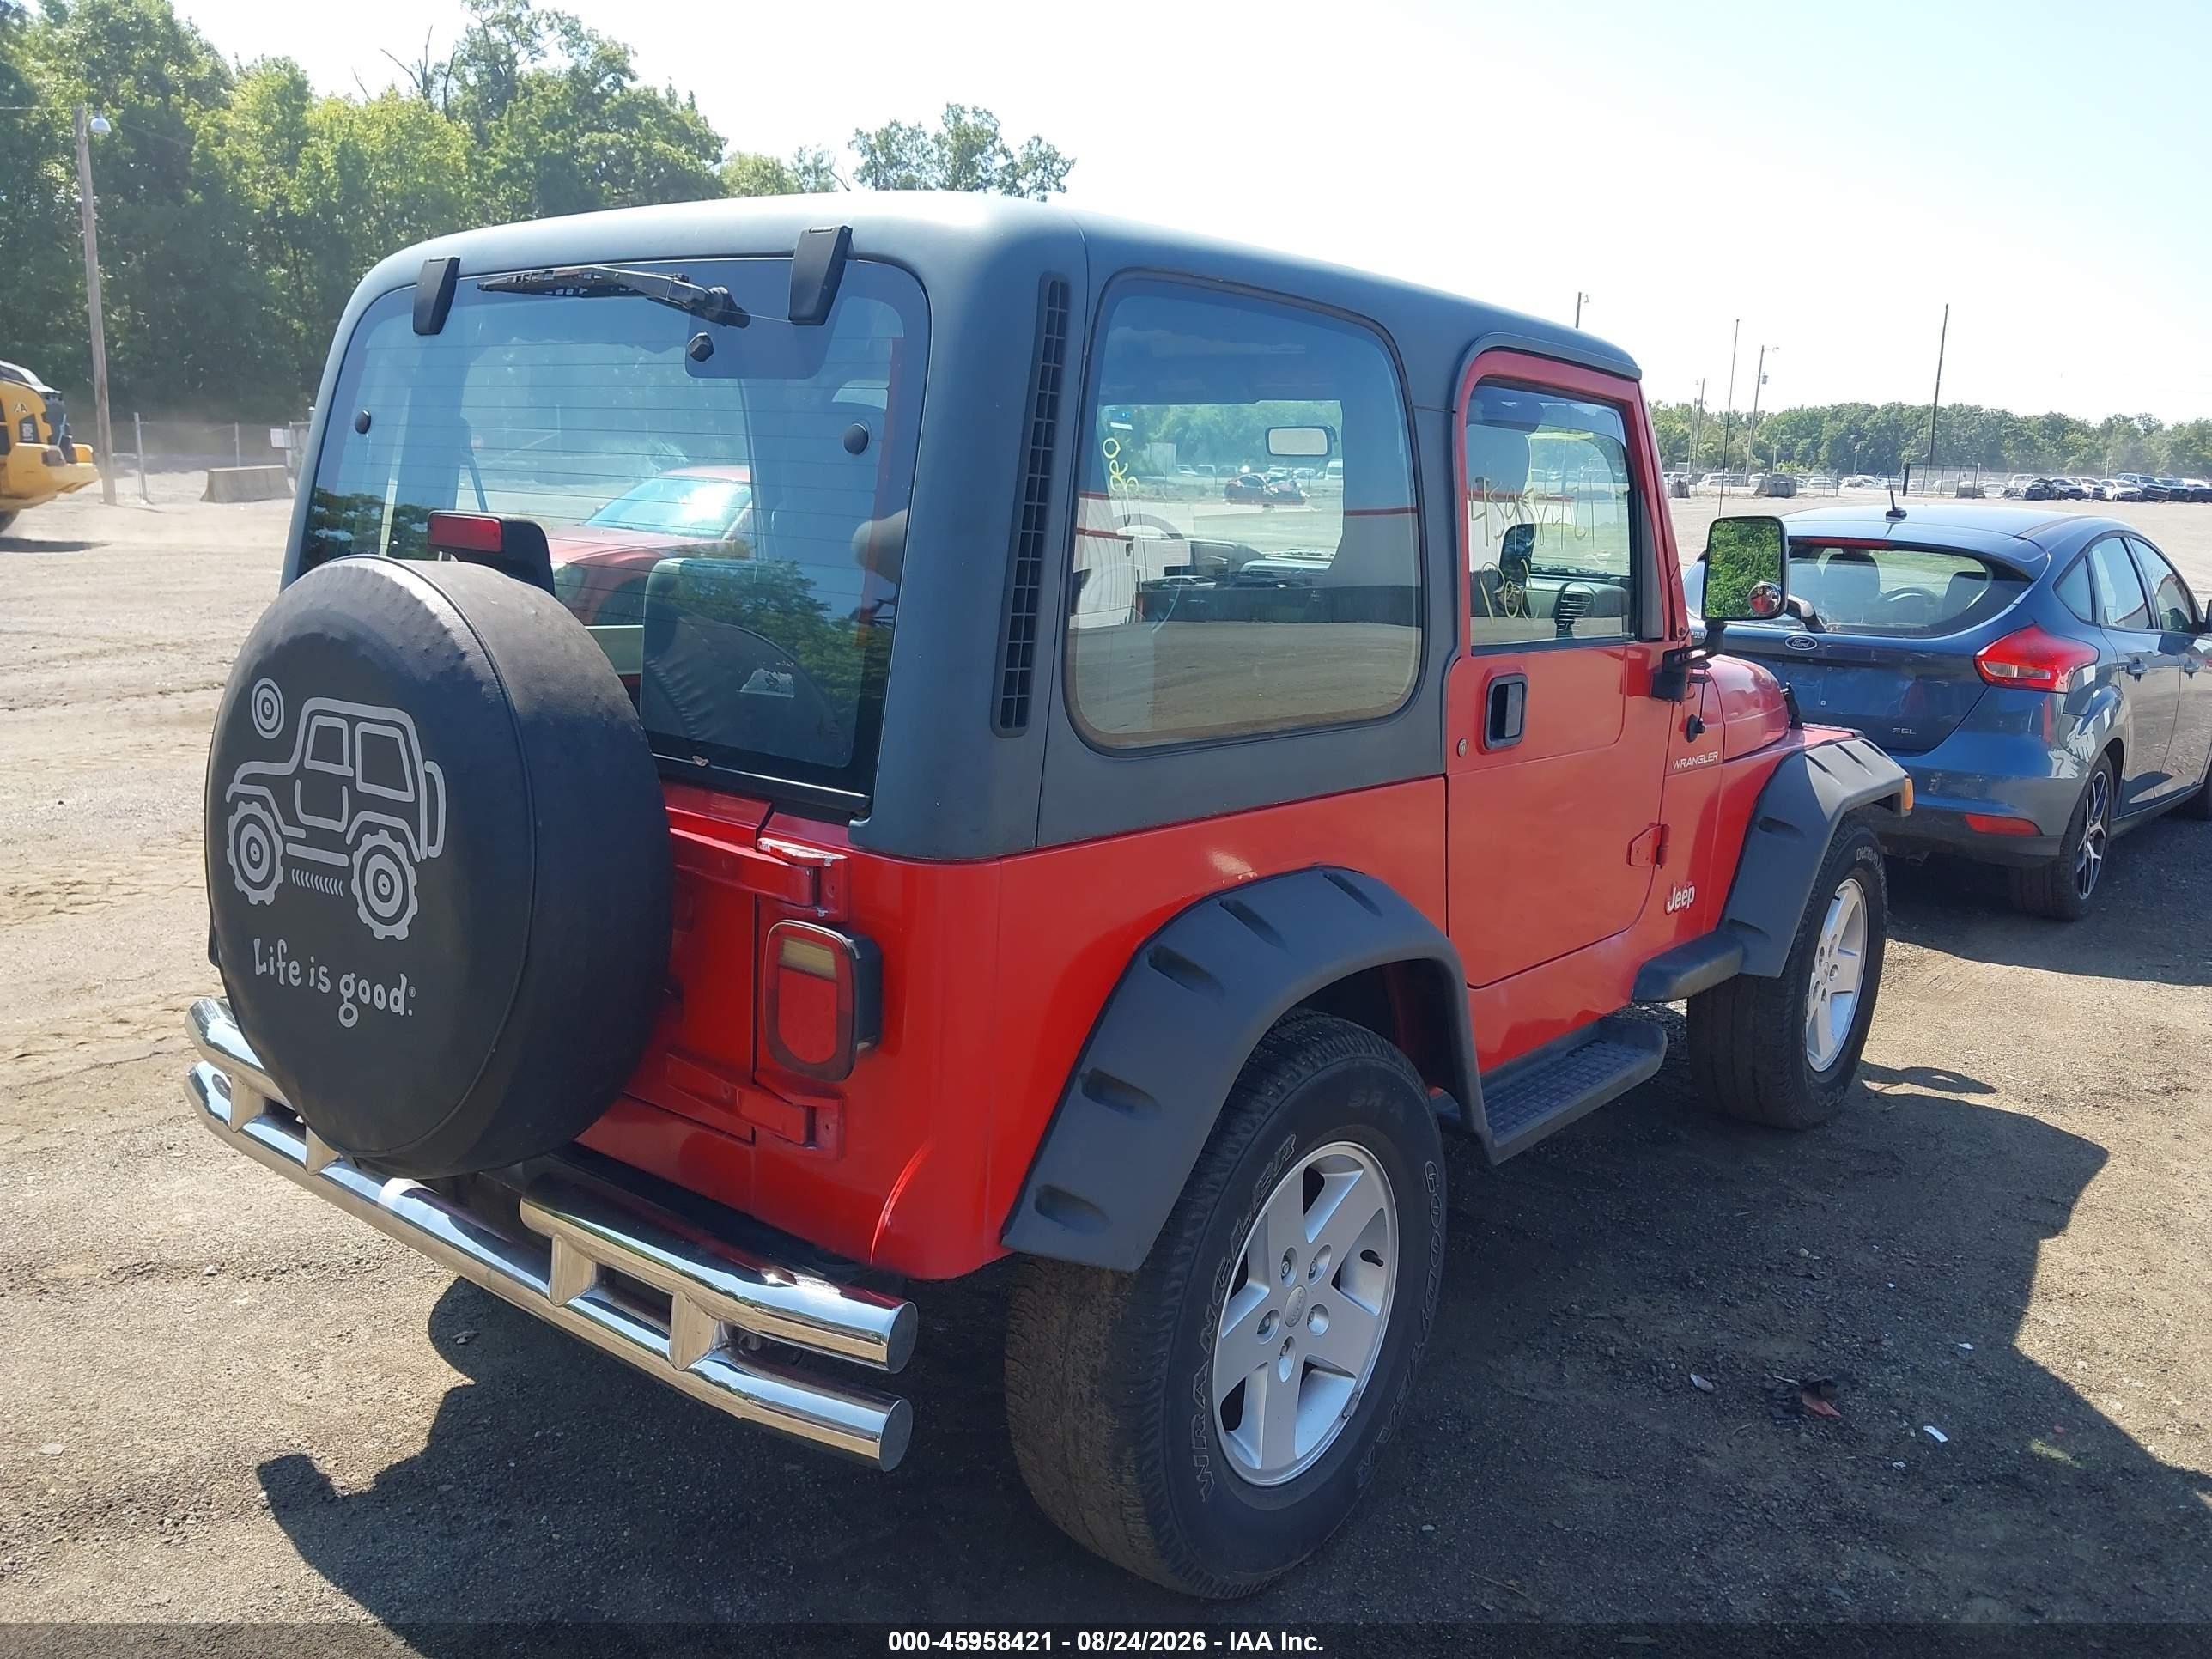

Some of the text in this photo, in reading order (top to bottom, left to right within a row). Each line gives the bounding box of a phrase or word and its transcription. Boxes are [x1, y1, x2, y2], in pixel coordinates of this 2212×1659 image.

[1672, 750, 1719, 770] WRANGLER
[1667, 885, 1696, 912] Jeep
[253, 938, 301, 987] Life
[309, 956, 331, 993] is
[1190, 1133, 1297, 1503] WRANGLER
